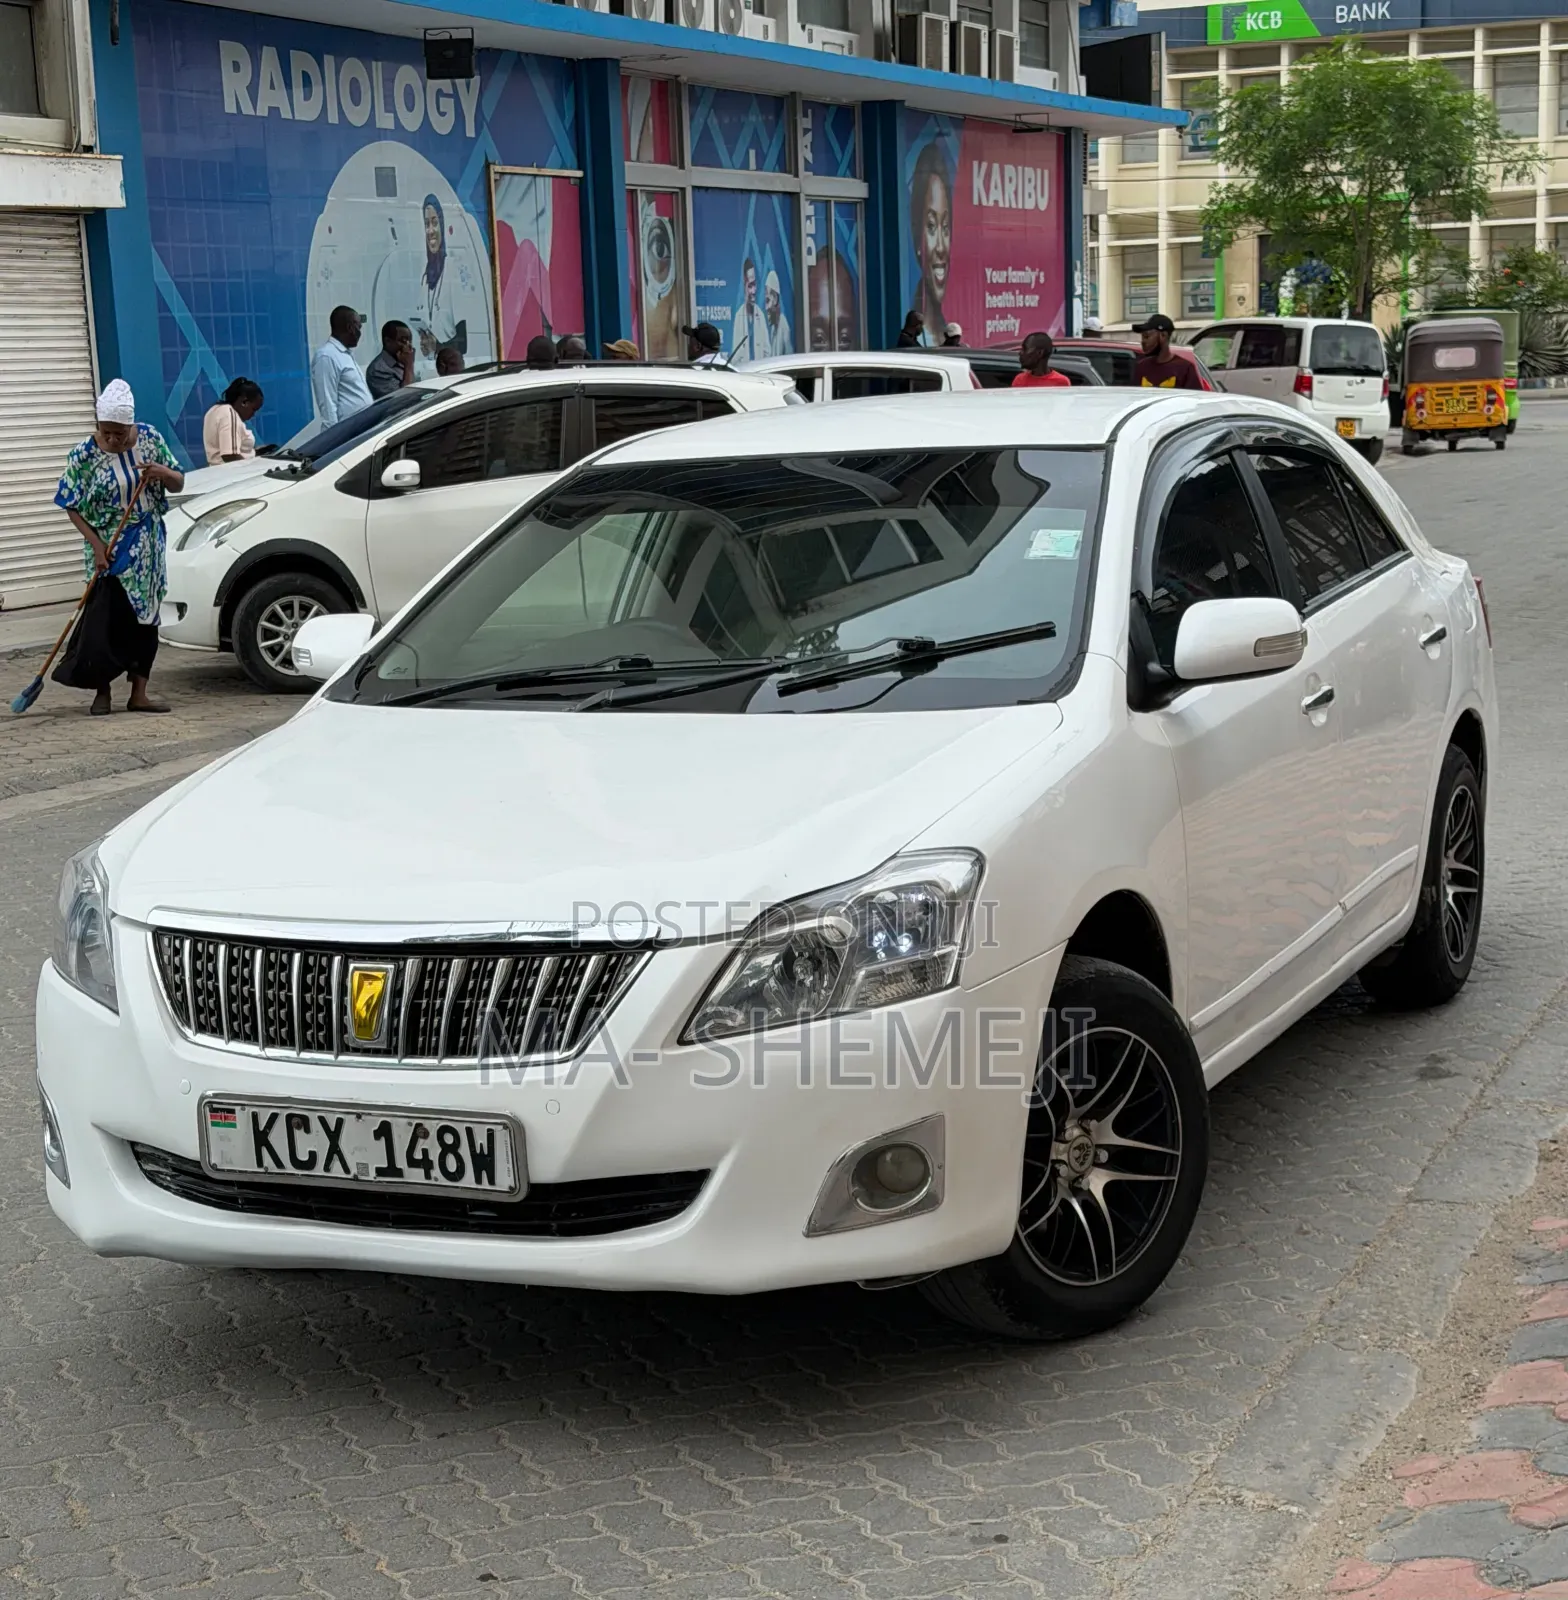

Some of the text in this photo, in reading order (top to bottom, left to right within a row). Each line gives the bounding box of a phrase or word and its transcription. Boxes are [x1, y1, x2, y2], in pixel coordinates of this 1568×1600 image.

[1246, 1, 1392, 31] KCB BANK
[219, 40, 481, 138] RADIOLOGY
[802, 108, 817, 266] DENAL
[972, 160, 1049, 212] KARIBU
[985, 267, 1007, 284] Your
[710, 306, 732, 321] PASSION
[985, 289, 1040, 309] health is our
[985, 313, 1021, 339] priority
[251, 1110, 352, 1176] KCX
[372, 1118, 497, 1187] 148W
